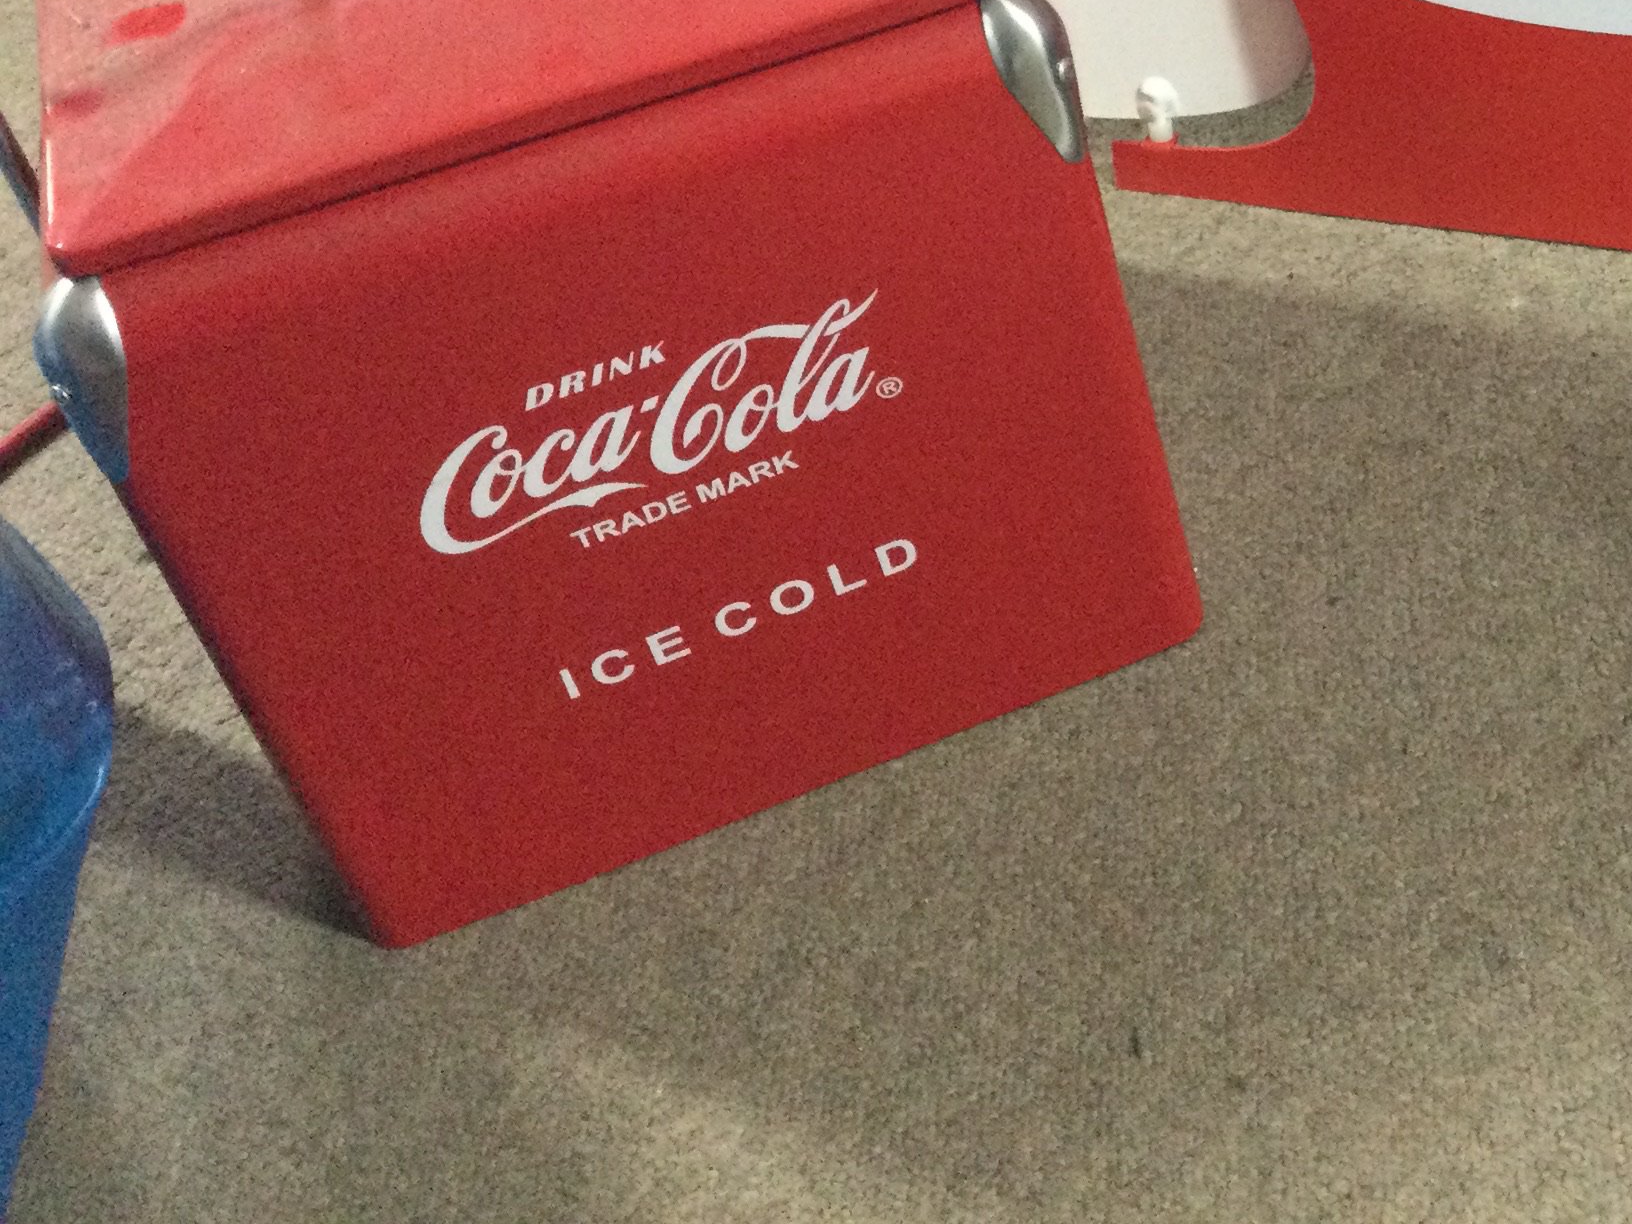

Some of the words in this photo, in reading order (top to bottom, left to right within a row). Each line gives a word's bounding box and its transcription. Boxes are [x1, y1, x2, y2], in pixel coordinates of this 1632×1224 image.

[419, 288, 878, 555] Coca-Cola
[525, 340, 665, 411] DRINK
[569, 490, 692, 548] TRADE
[696, 450, 799, 503] MARK
[559, 625, 692, 700] ICE
[714, 538, 918, 637] COLD
